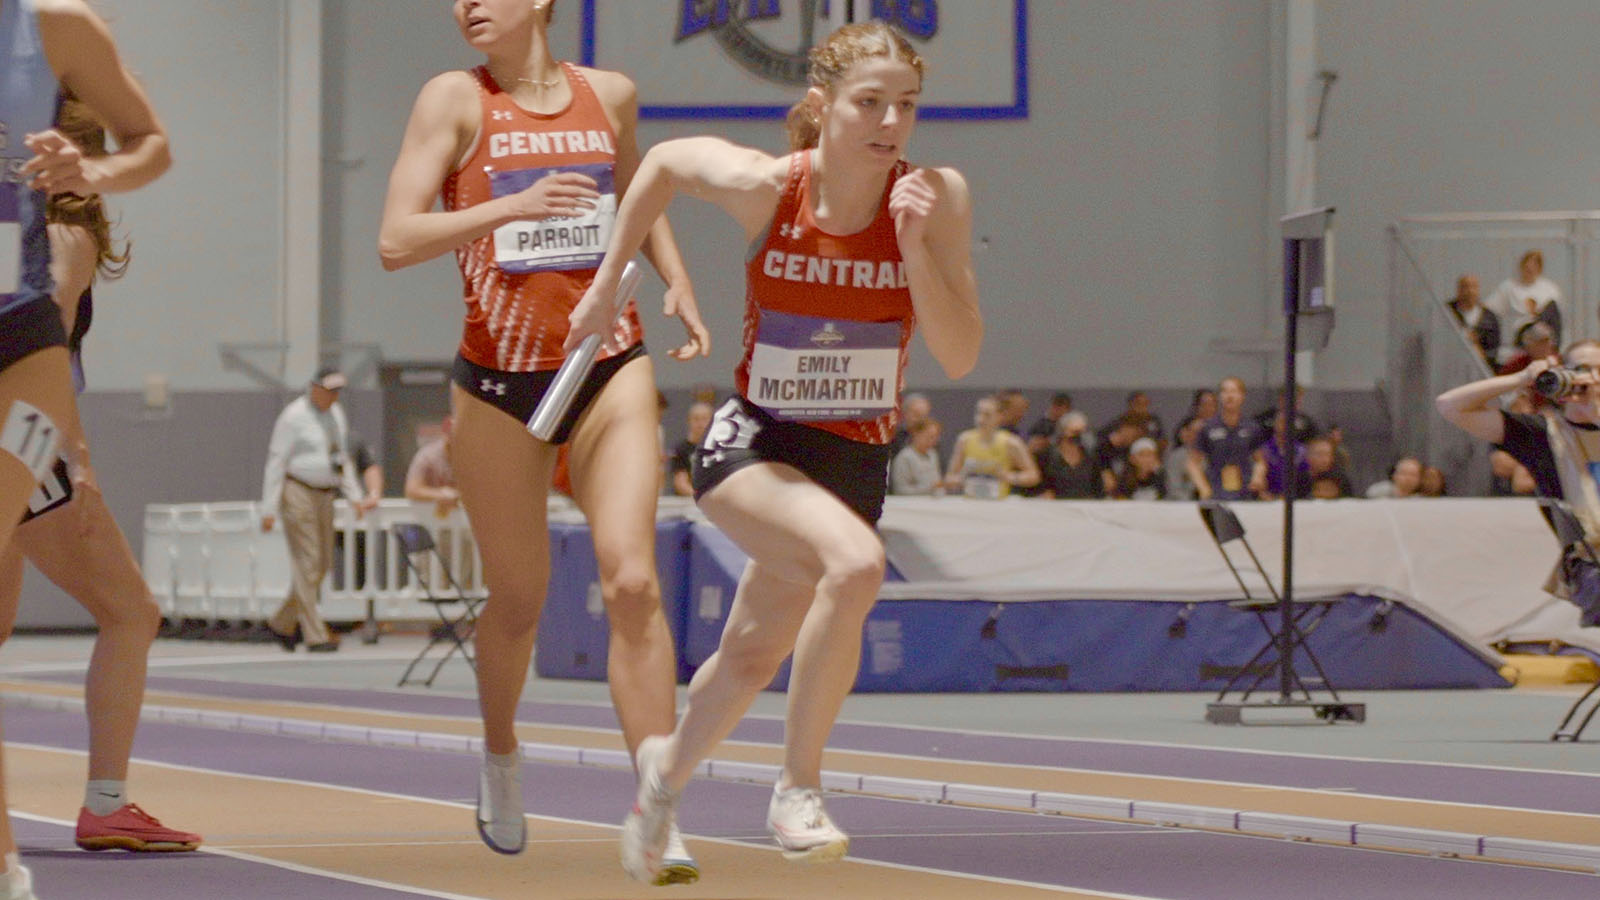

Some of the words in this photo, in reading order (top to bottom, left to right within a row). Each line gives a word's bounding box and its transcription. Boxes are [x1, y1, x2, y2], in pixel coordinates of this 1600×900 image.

[489, 130, 615, 158] CENTRAL
[517, 224, 600, 252] PARROTT
[797, 356, 852, 374] EMILY
[758, 377, 885, 401] MCMARTIN
